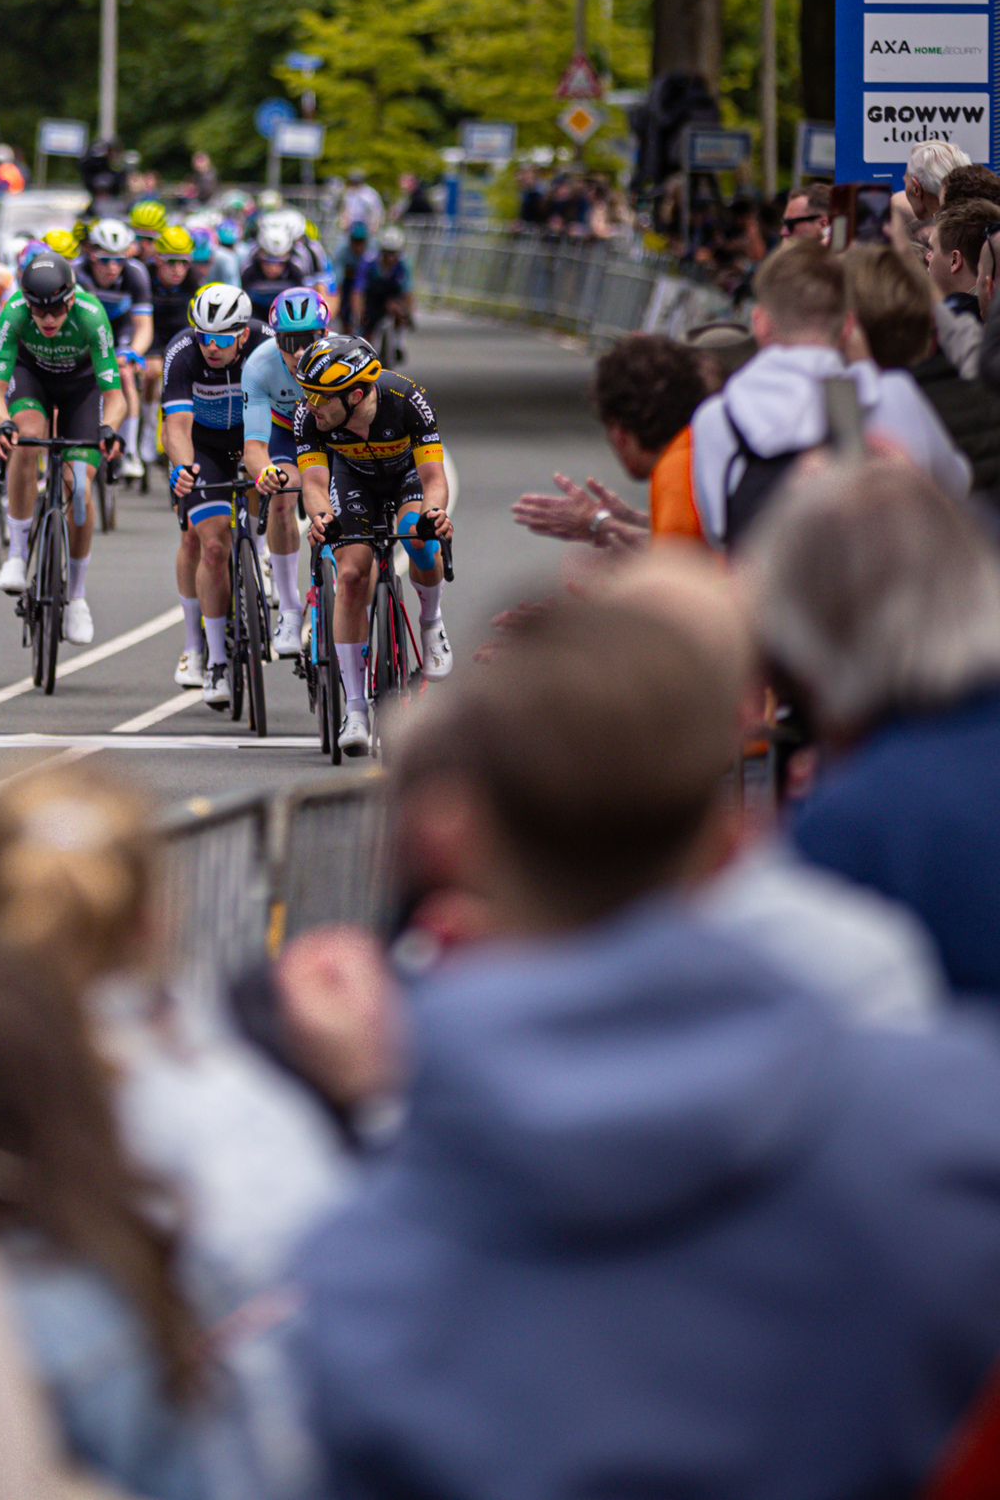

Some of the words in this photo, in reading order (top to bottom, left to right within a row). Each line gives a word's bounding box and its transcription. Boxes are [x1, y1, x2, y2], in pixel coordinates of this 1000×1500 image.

[869, 39, 912, 54] AXA
[914, 46, 942, 55] HOME
[867, 105, 985, 124] GROWWW
[411, 391, 435, 425] TWZK
